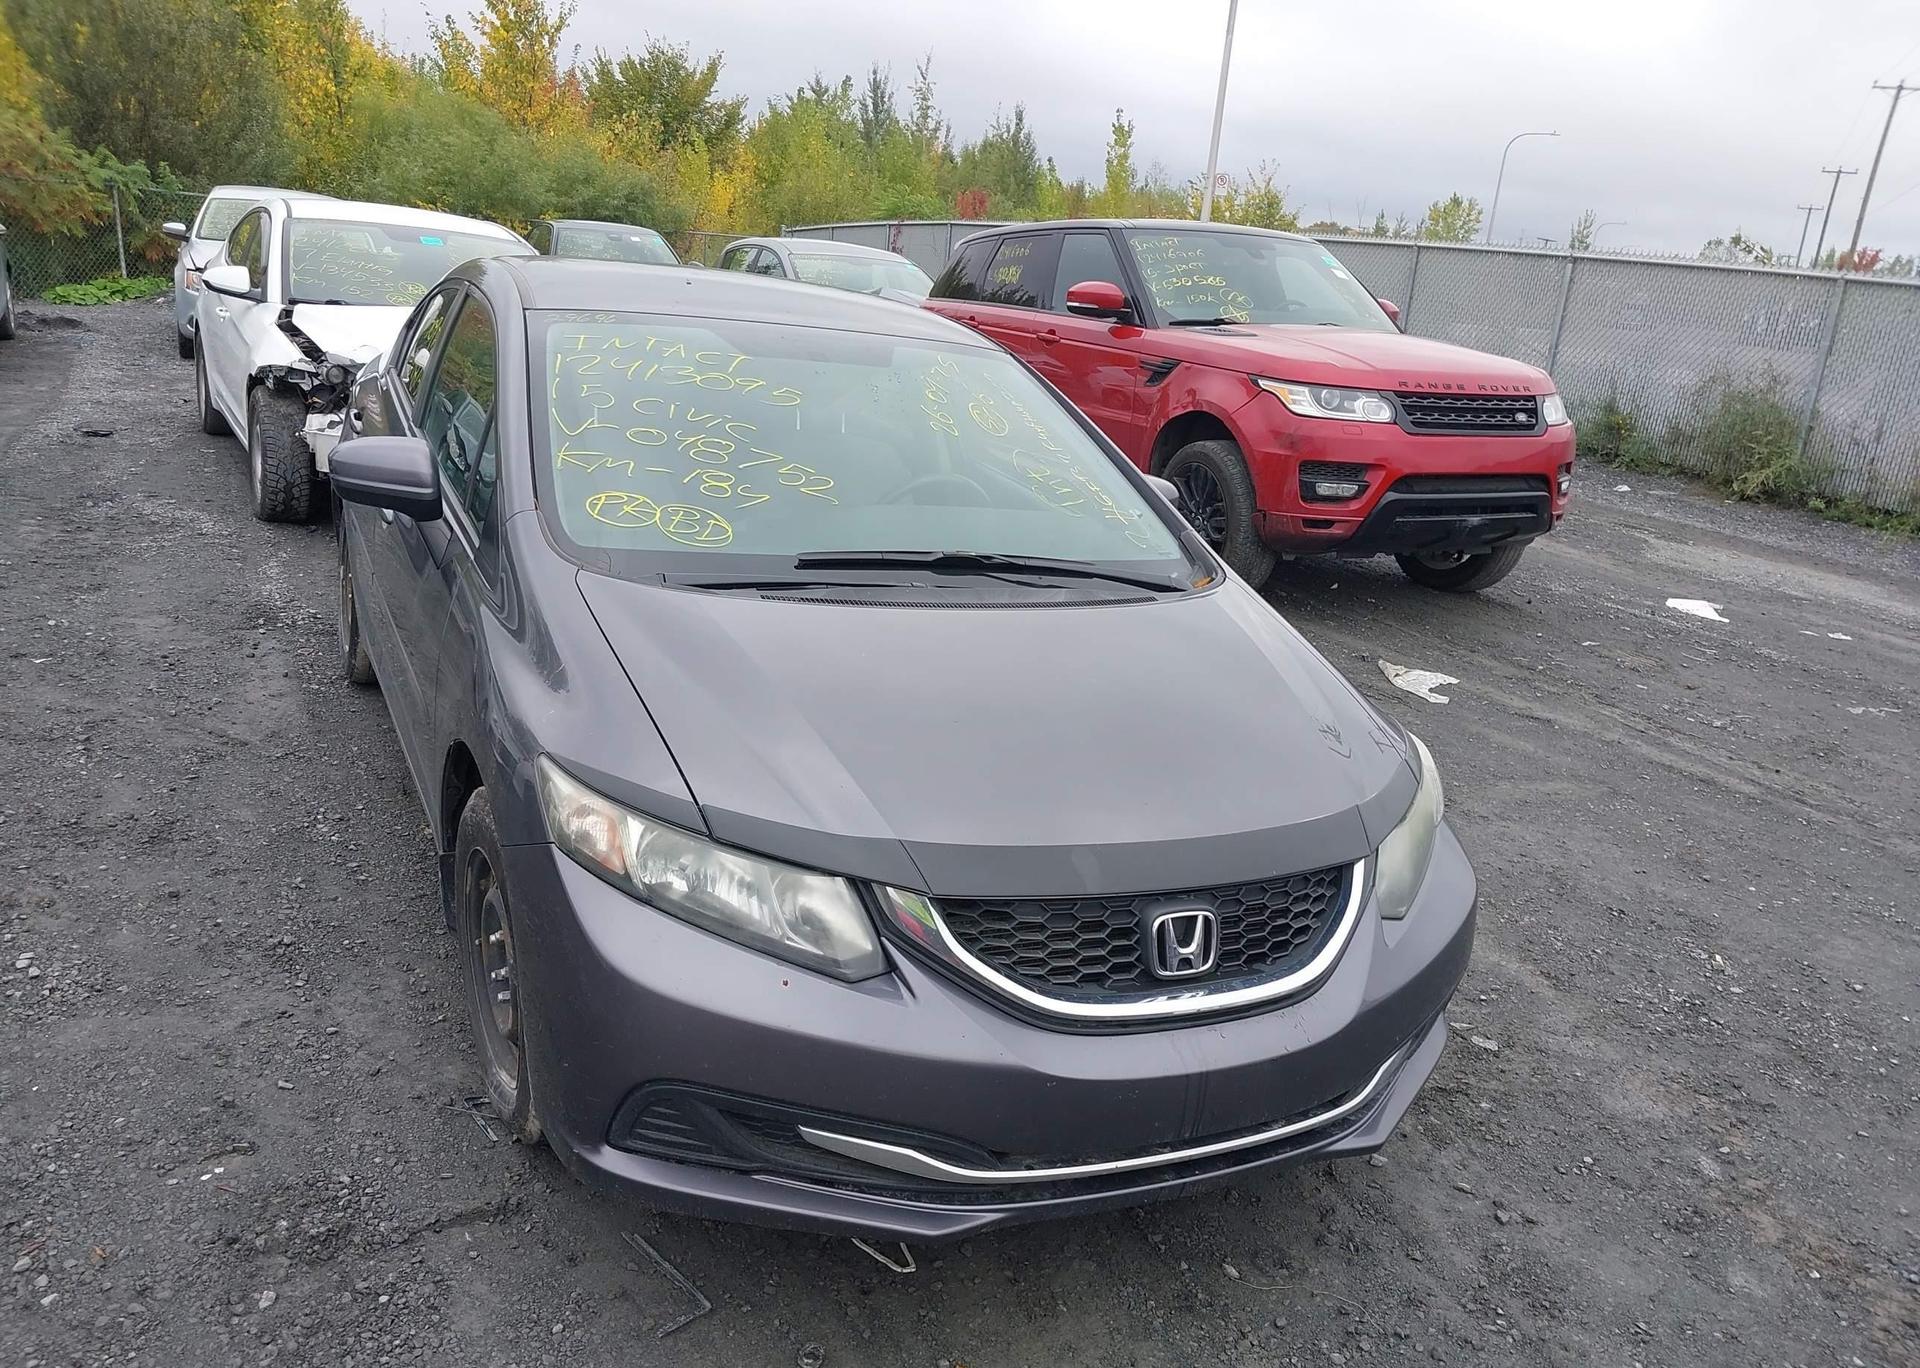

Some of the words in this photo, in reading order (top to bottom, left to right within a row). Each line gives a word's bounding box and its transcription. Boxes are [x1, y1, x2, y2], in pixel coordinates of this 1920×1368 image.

[563, 333, 753, 373] INTACT
[554, 353, 803, 407] 12413095
[1398, 380, 1466, 391] RANGE
[1478, 383, 1532, 393] ROVER
